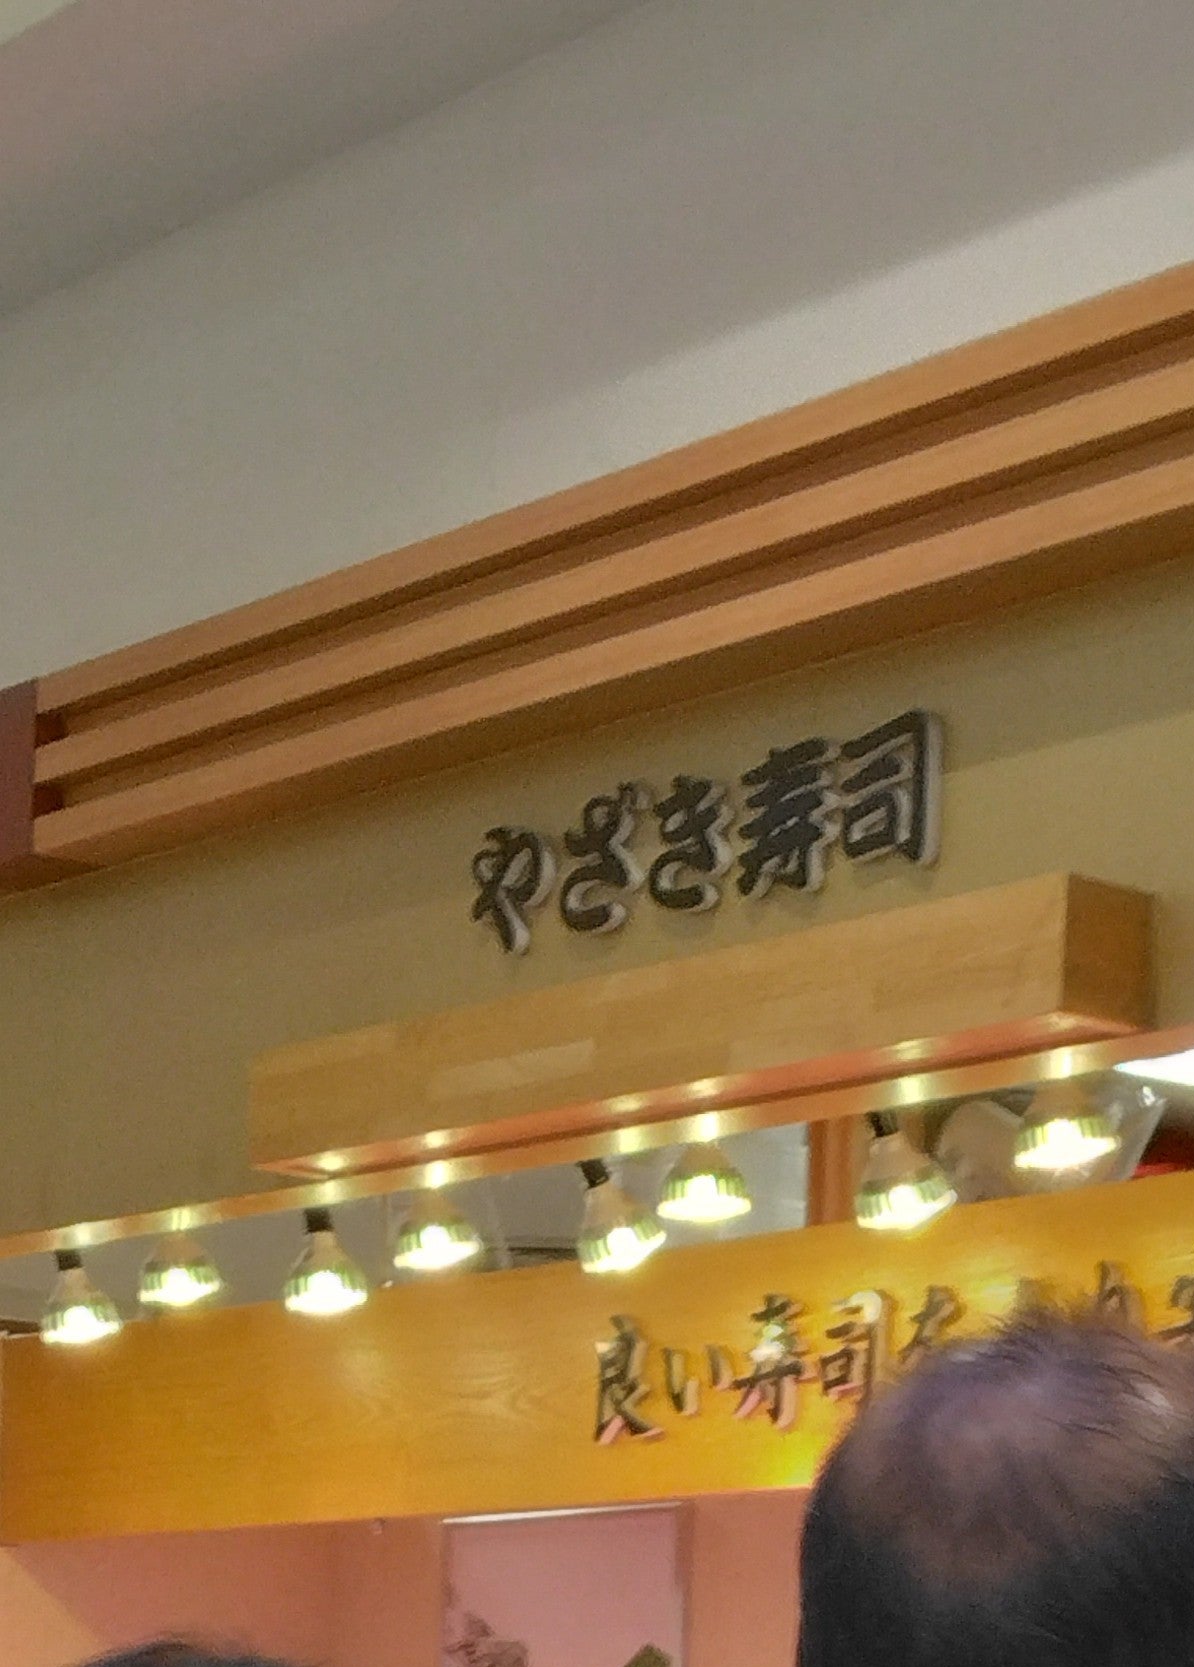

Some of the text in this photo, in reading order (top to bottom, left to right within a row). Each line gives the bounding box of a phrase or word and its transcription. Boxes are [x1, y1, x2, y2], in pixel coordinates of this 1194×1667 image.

[472, 708, 943, 955] やざき寿司
